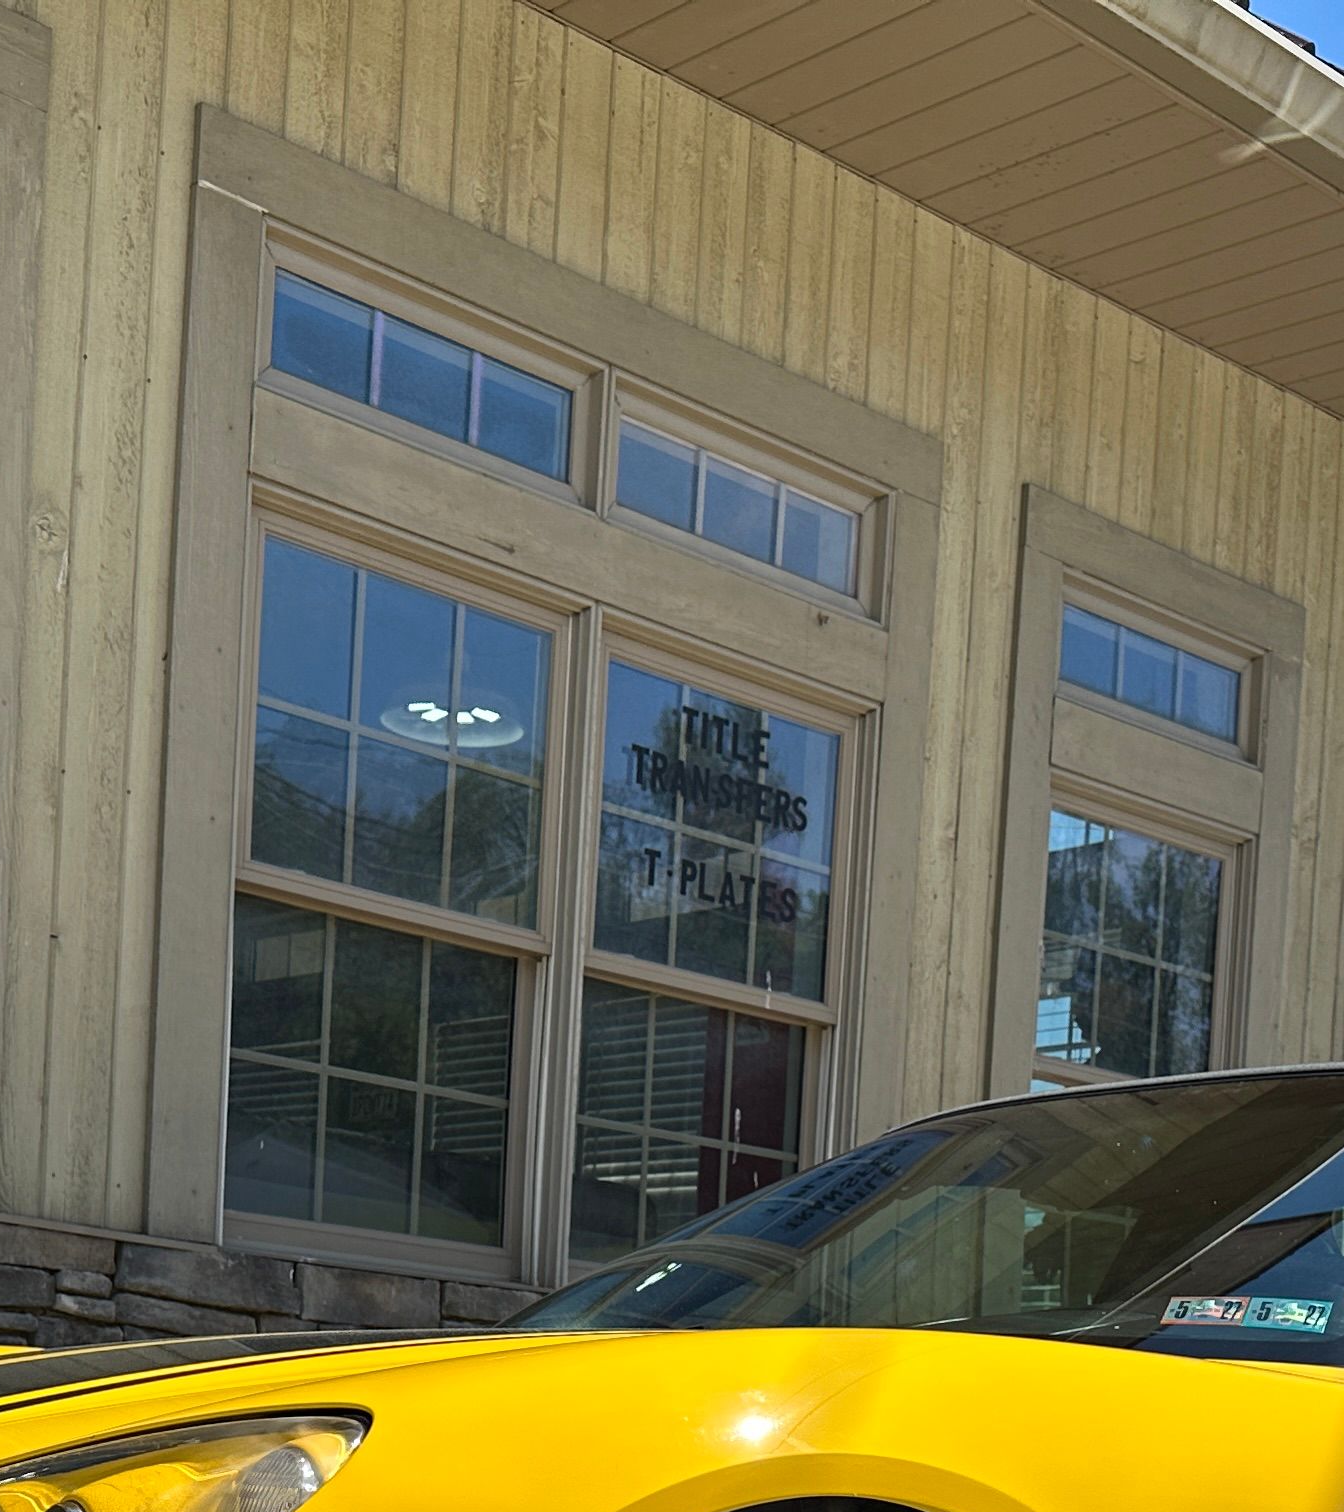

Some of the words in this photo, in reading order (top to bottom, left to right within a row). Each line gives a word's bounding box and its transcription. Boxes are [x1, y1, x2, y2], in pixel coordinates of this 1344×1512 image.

[682, 706, 771, 769] TITLE
[630, 743, 809, 832] TRANSFERS
[1174, 1300, 1191, 1319] 5
[1219, 1300, 1243, 1321] 27
[1256, 1301, 1273, 1321] 5
[1302, 1304, 1326, 1327] 27
